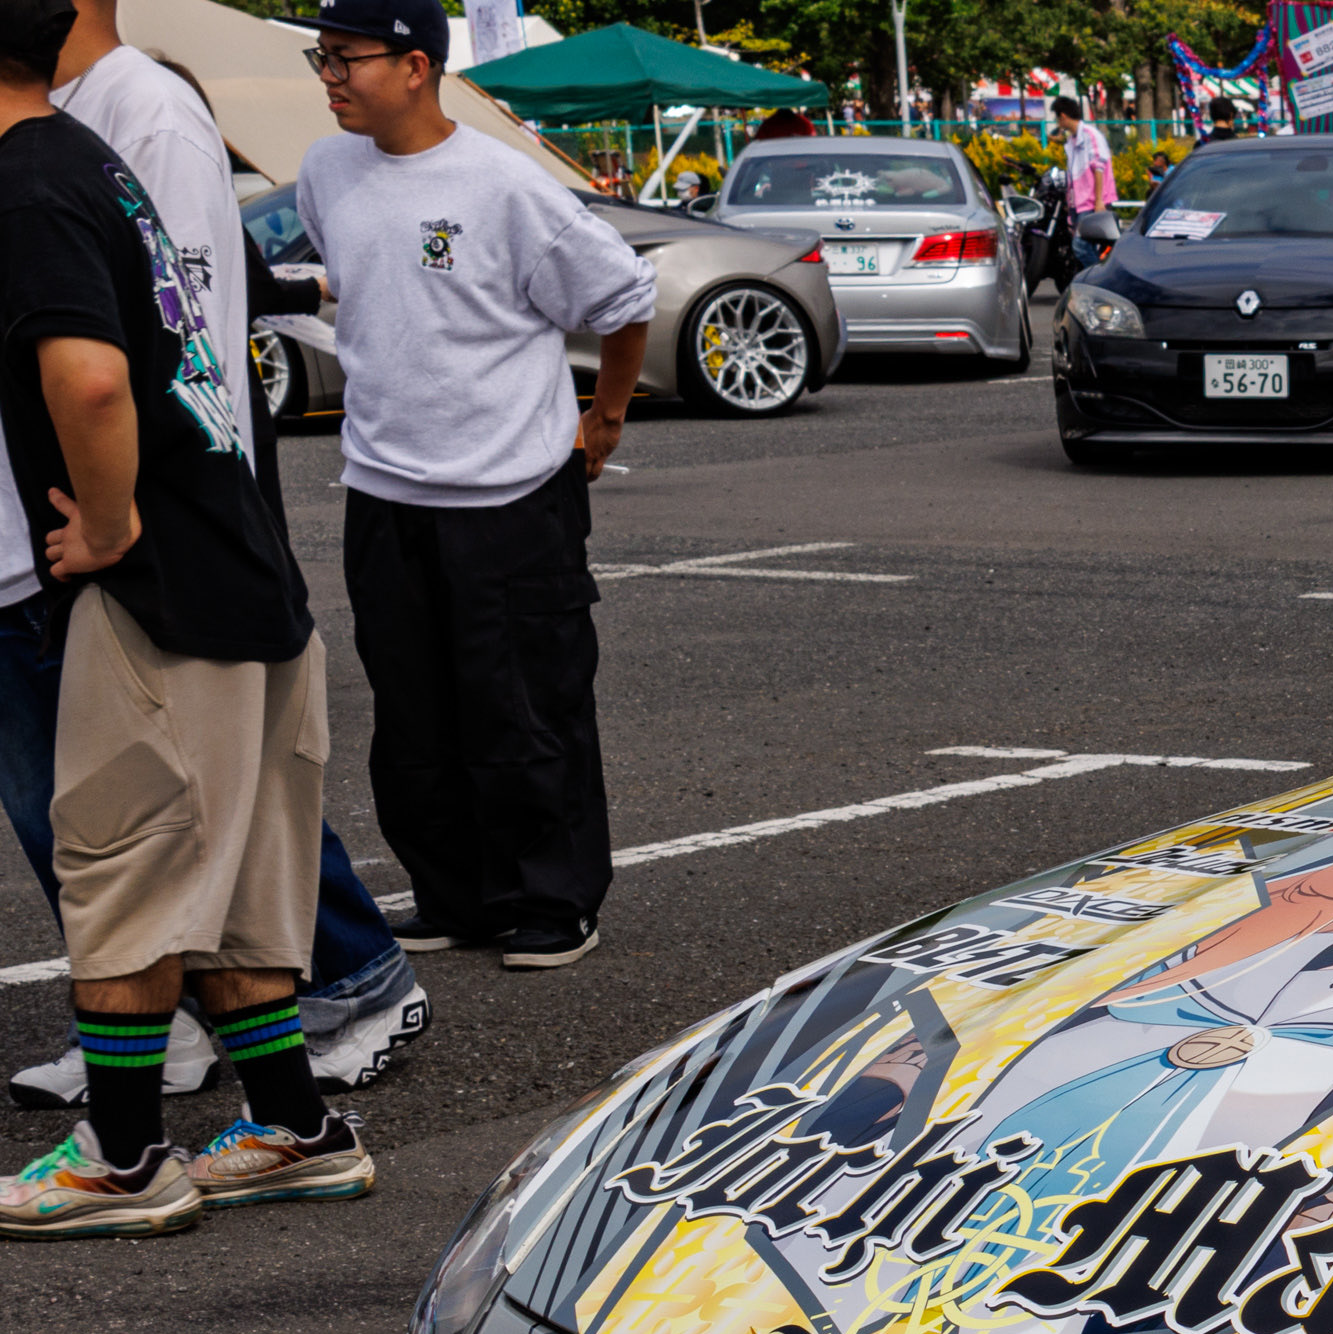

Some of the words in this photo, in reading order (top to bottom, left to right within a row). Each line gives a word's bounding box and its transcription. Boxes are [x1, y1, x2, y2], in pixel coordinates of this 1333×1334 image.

[857, 256, 876, 272] 96
[1225, 359, 1247, 370] 岡崎
[1249, 359, 1269, 370] 300
[1223, 372, 1283, 394] 56-70
[1000, 888, 1175, 921] DIXCEL
[866, 928, 1105, 986] BLITZ
